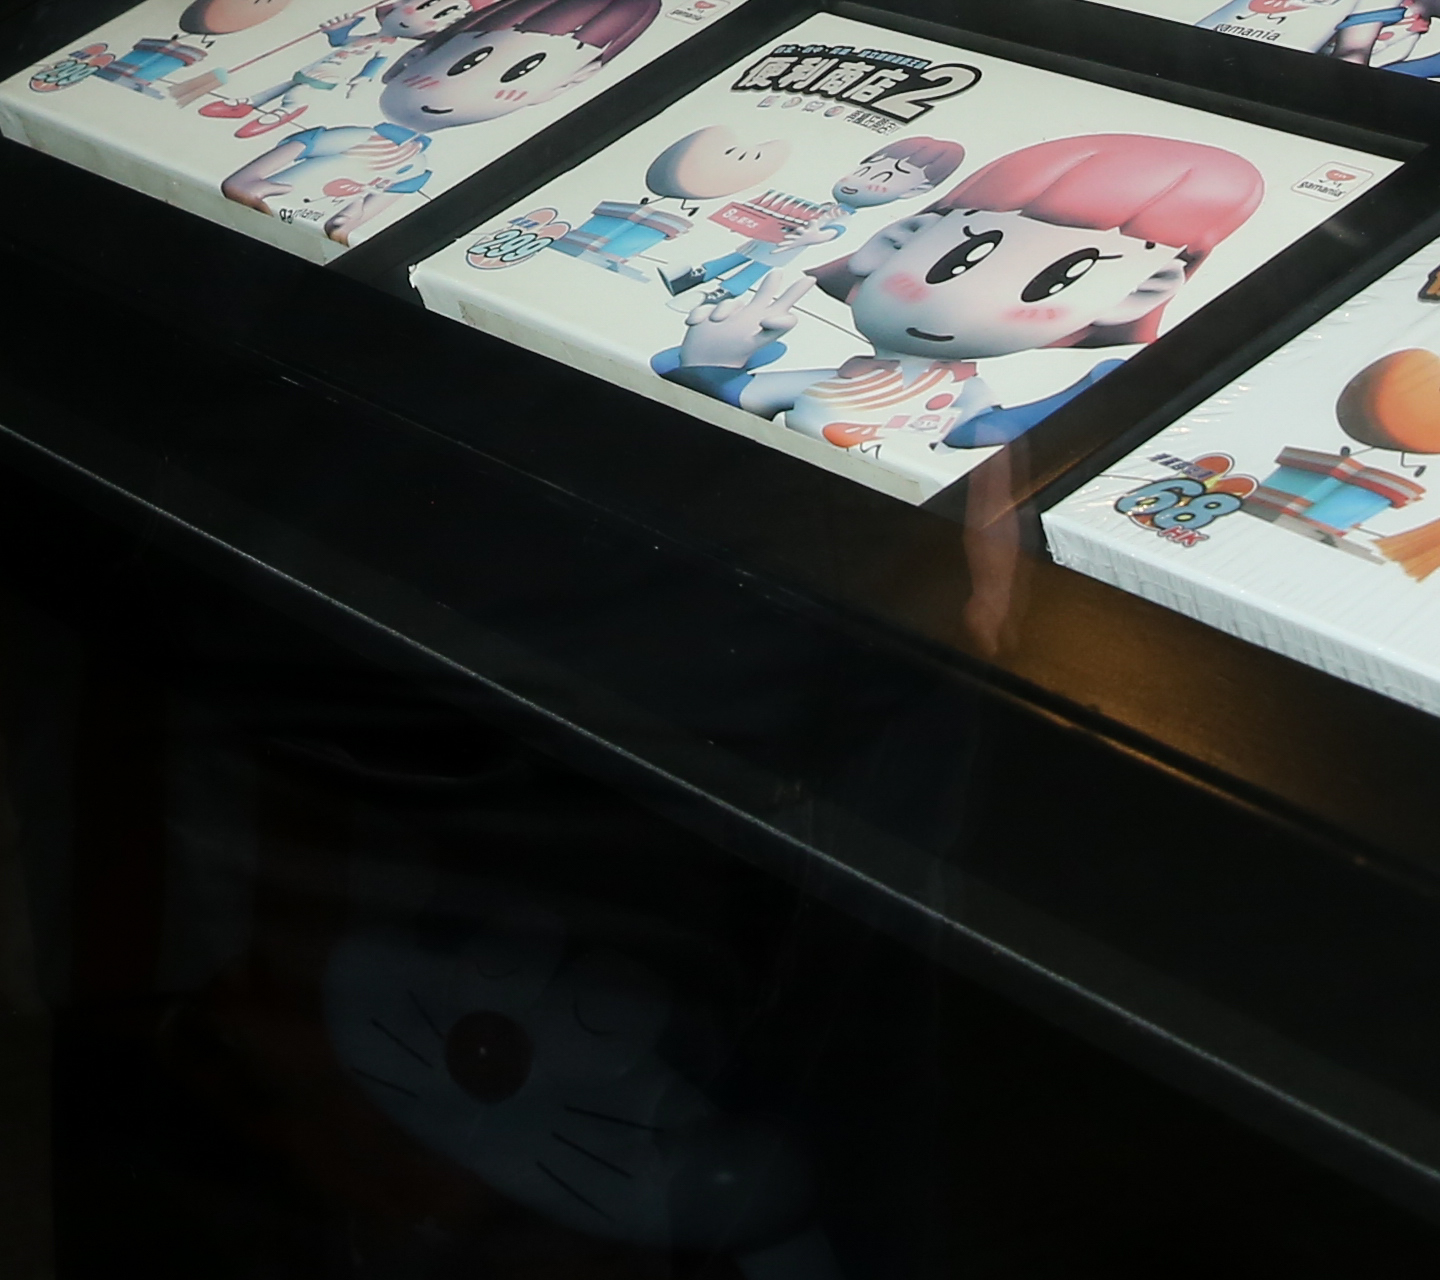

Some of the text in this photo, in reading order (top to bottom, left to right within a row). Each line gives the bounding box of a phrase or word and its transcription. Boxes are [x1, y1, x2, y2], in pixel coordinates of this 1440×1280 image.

[731, 56, 983, 124] 便利商店2
[1297, 181, 1343, 197] gamania
[467, 228, 555, 263] 299
[1114, 477, 1244, 531] 68
[1158, 525, 1210, 548] HK
